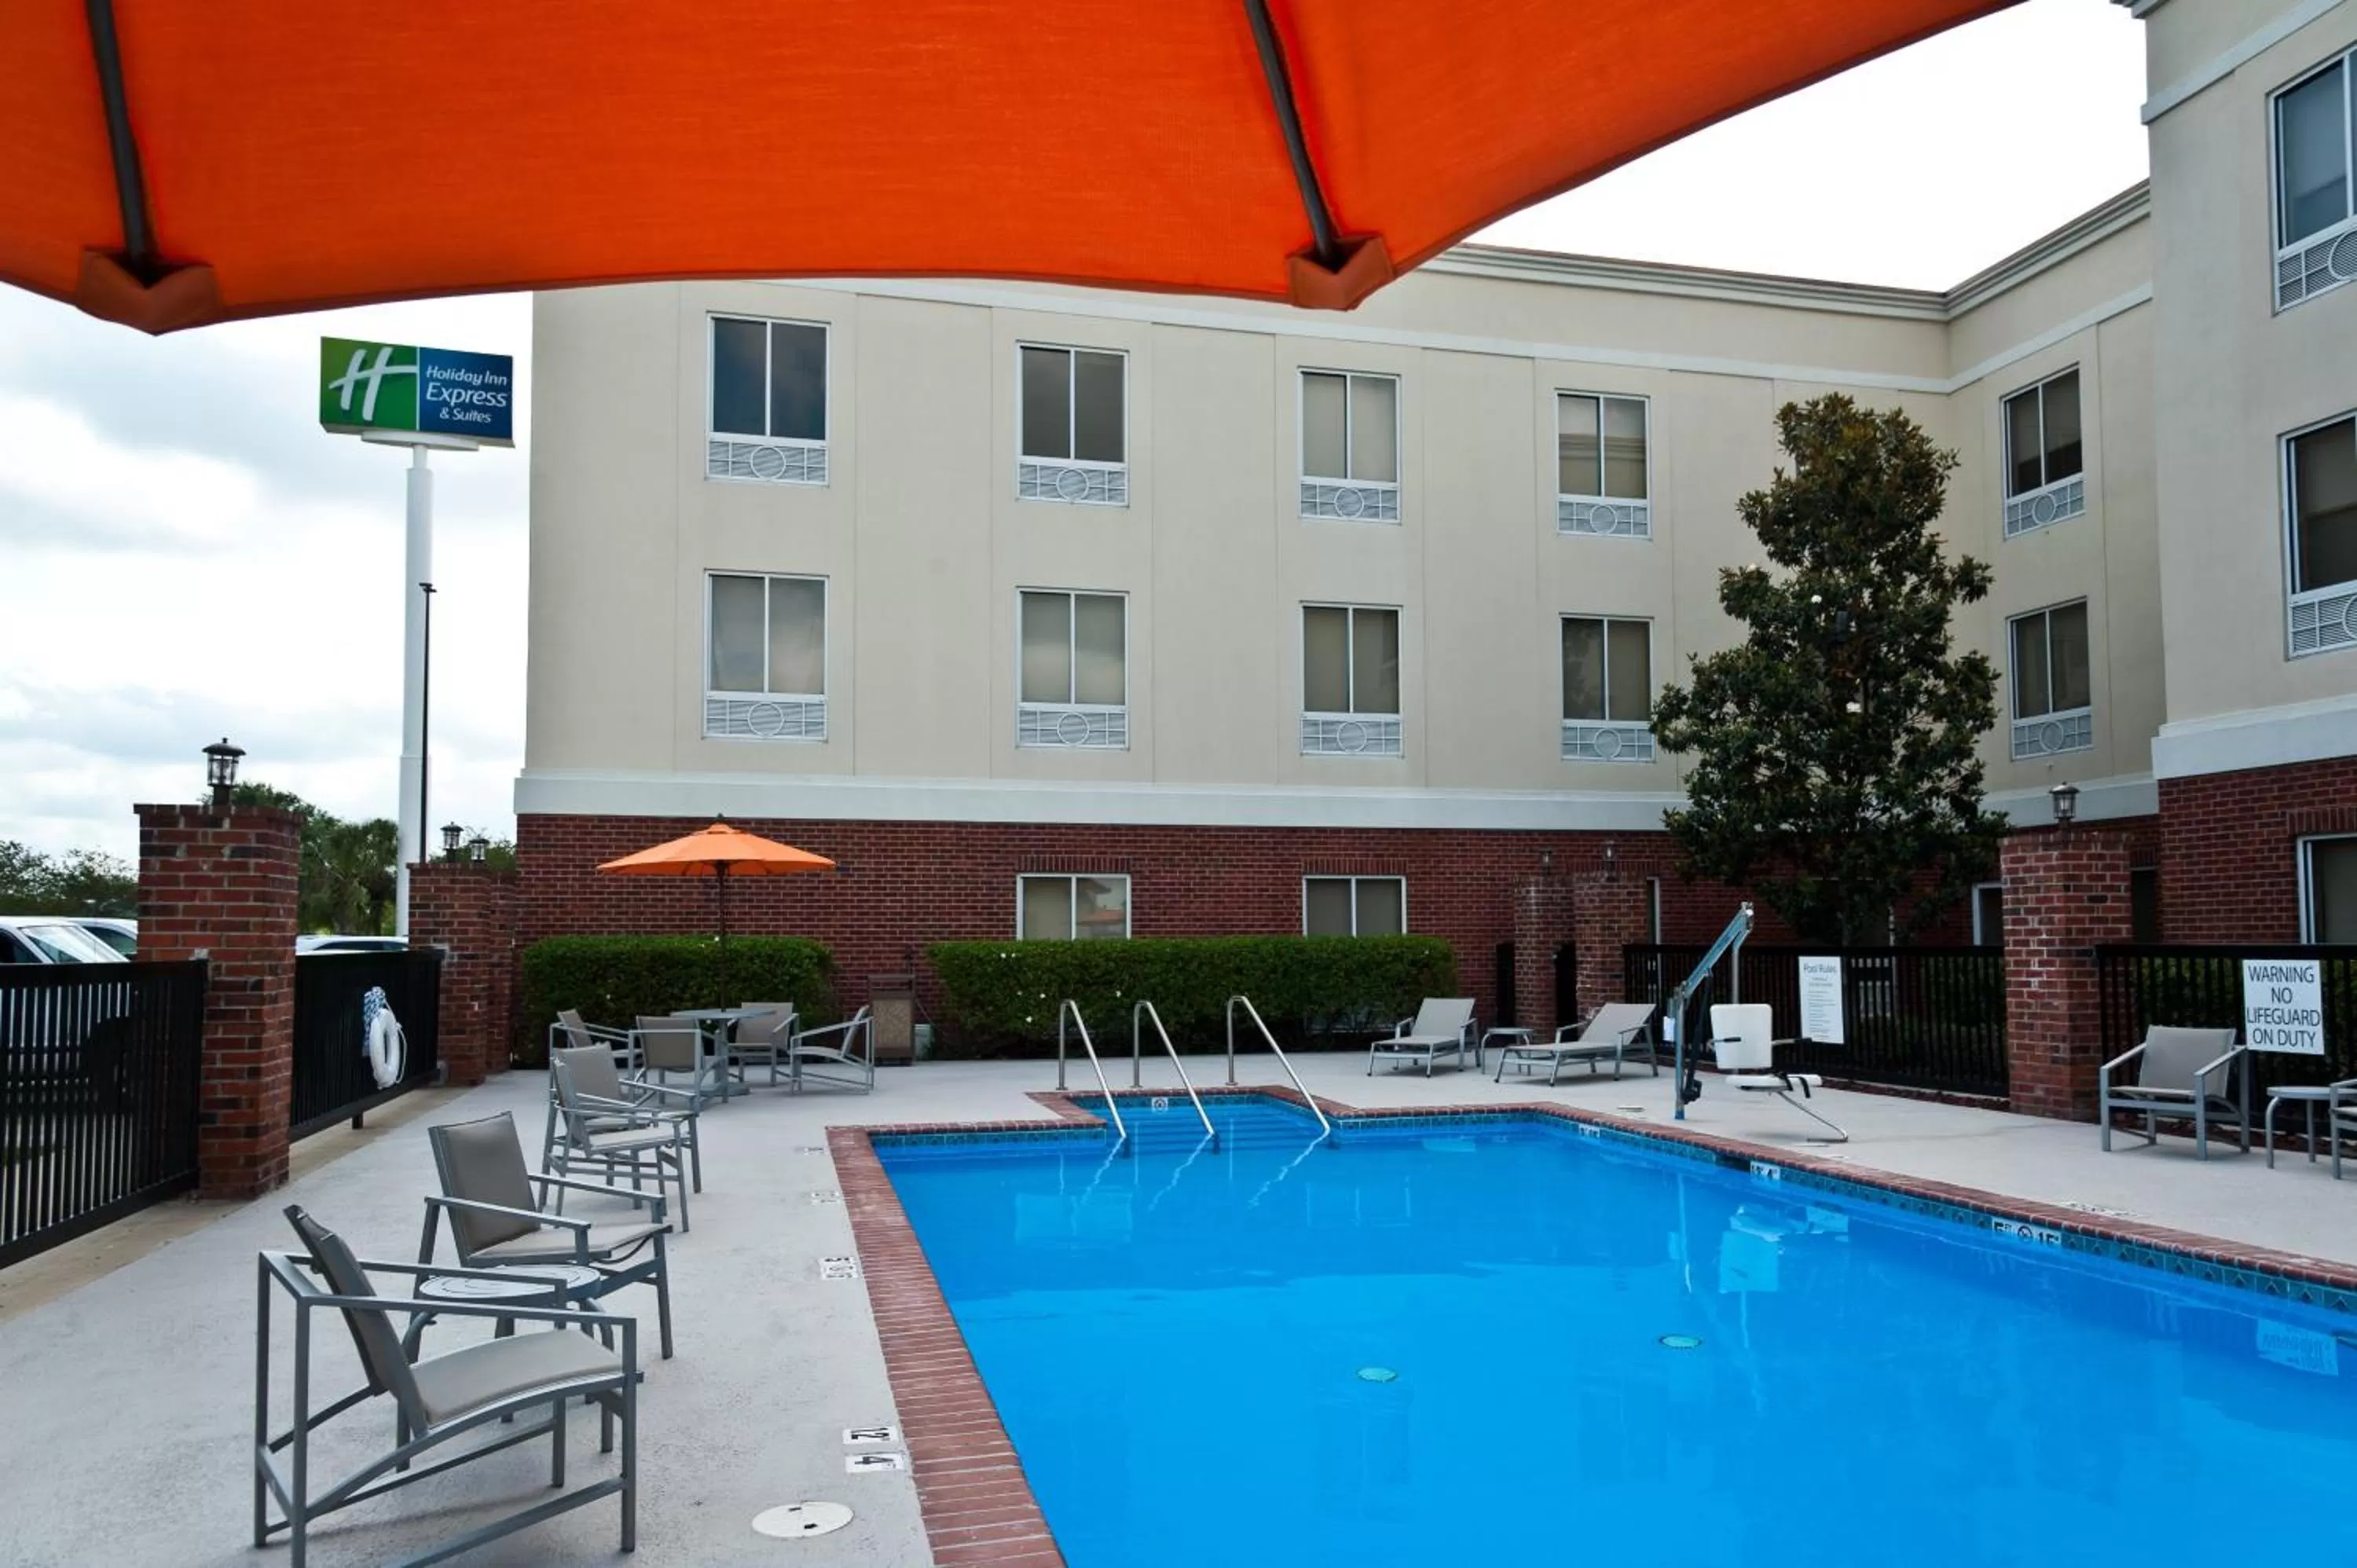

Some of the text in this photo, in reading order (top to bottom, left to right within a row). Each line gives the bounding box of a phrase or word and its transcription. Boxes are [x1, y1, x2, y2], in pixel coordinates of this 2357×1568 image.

[426, 365, 508, 386] Holiday Inn
[426, 383, 508, 408] Express
[439, 406, 492, 423] & Suites
[2247, 965, 2315, 983] WARNING
[2271, 987, 2293, 1004] NO
[2246, 1007, 2321, 1027] LIFEGUARD
[2253, 1028, 2316, 1047] ON DUTY
